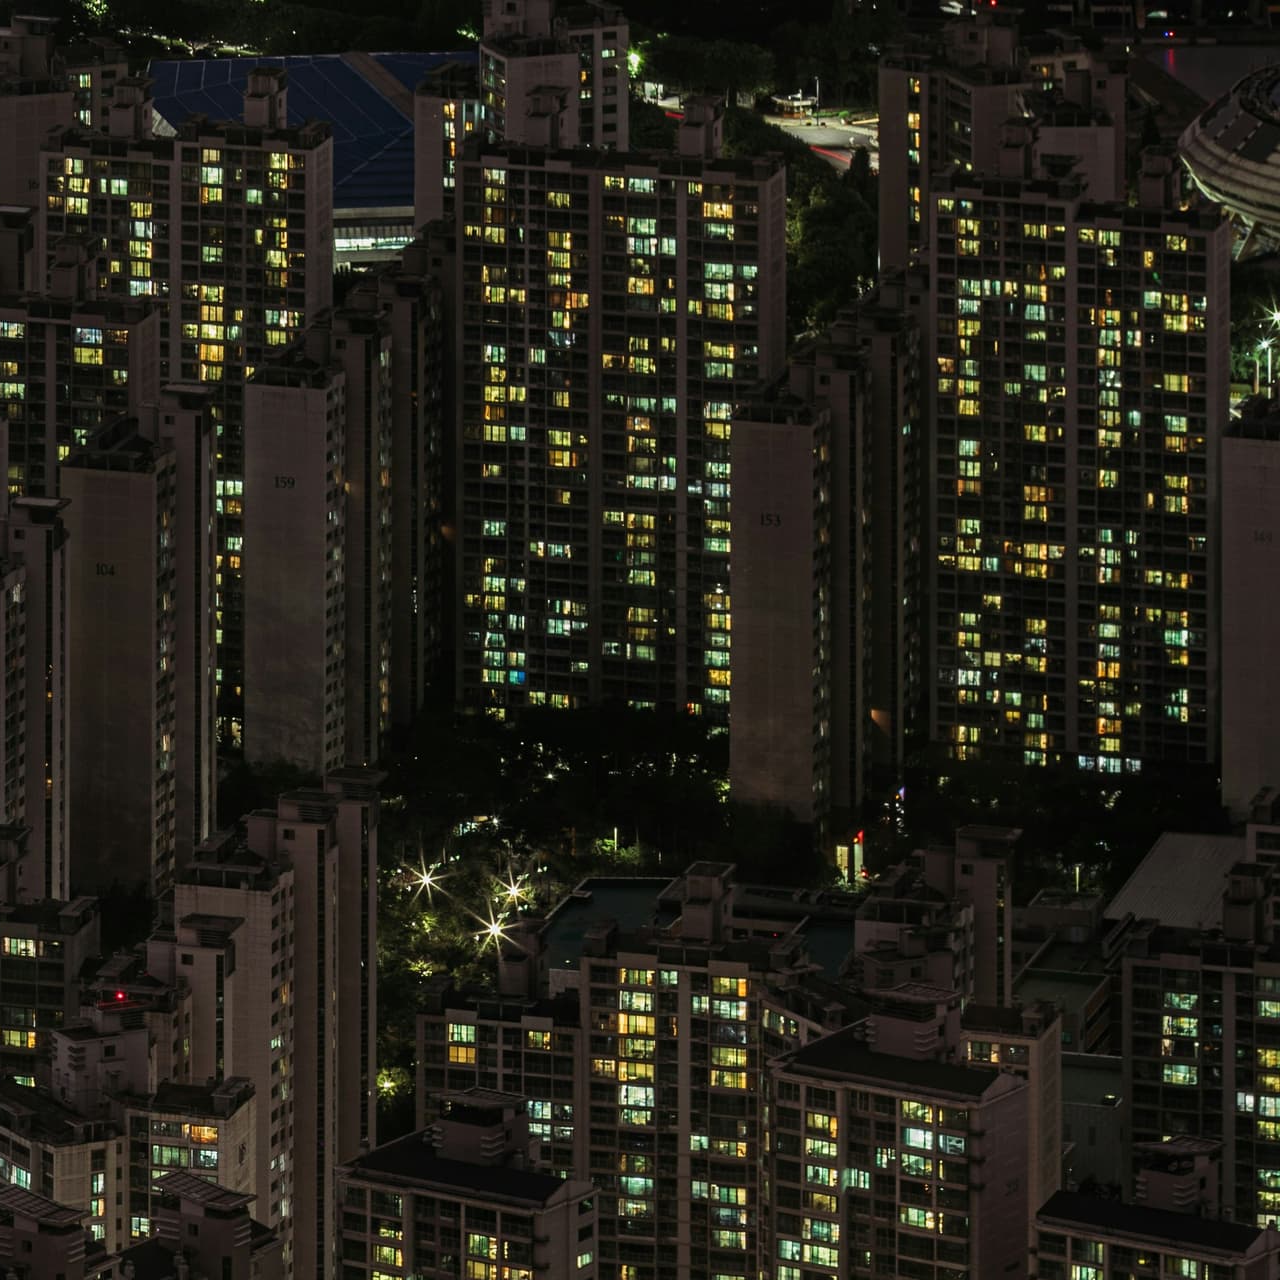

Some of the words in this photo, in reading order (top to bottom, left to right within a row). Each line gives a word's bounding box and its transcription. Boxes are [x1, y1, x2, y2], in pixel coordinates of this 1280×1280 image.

[274, 475, 296, 489] 159
[760, 513, 782, 527] 153
[96, 563, 115, 576] 104
